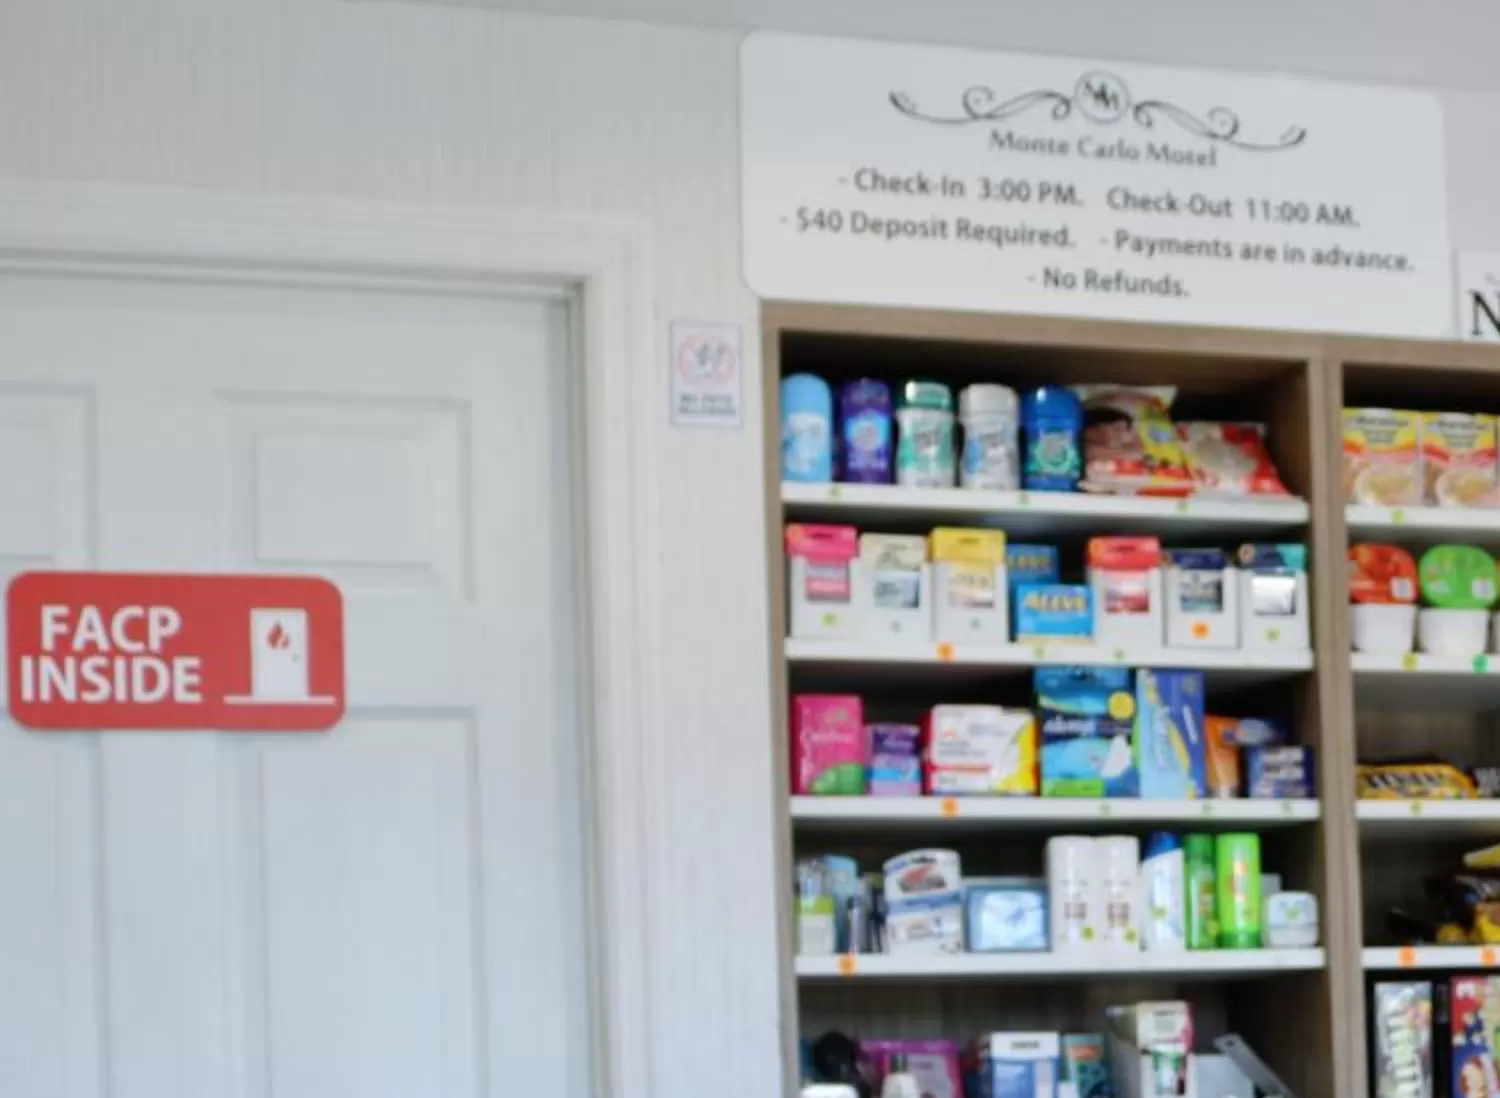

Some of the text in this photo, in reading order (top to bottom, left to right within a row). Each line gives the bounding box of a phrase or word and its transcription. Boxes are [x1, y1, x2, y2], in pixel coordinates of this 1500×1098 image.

[989, 129, 1218, 167] Monte Carlo Motel
[853, 166, 966, 198] Check-In
[977, 176, 1032, 202] 3:00
[1037, 180, 1083, 206] PM.
[1106, 186, 1234, 220] Check-Out
[1246, 197, 1310, 224] 11:00
[1315, 203, 1361, 228] AM.
[796, 207, 843, 233] $40
[850, 210, 948, 241] Deposit
[955, 217, 1077, 250] Required.
[1114, 229, 1233, 259] Payments
[1240, 241, 1277, 262] are
[1283, 242, 1305, 264] in
[1311, 245, 1416, 272] advance.
[1043, 266, 1078, 290] No
[1084, 268, 1190, 296] Refunds.
[41, 604, 182, 652] FACP
[20, 655, 203, 704] INSIDE
